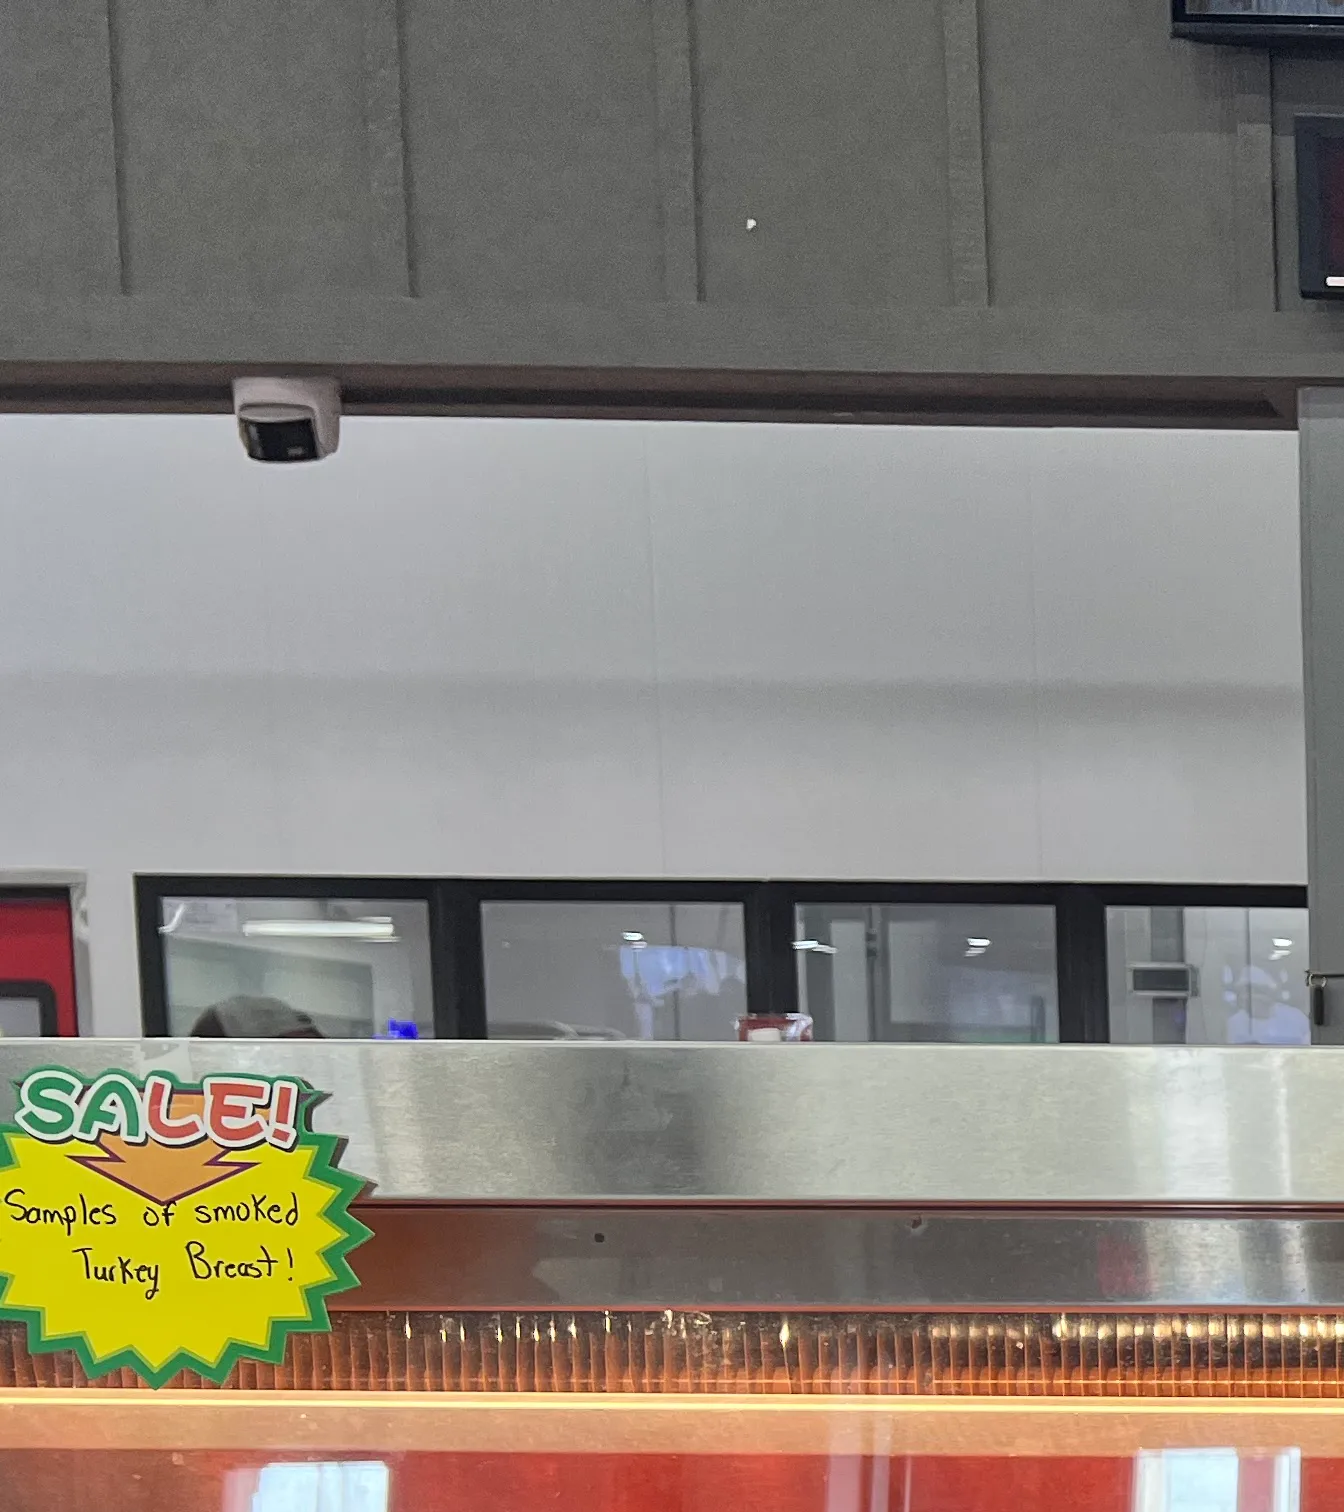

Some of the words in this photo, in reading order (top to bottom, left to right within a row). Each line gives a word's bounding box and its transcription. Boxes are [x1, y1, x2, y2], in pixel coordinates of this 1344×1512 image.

[16, 1070, 299, 1149] SALE!
[4, 1188, 117, 1236] Samples
[142, 1200, 177, 1227] of
[71, 1246, 160, 1301] Turkey
